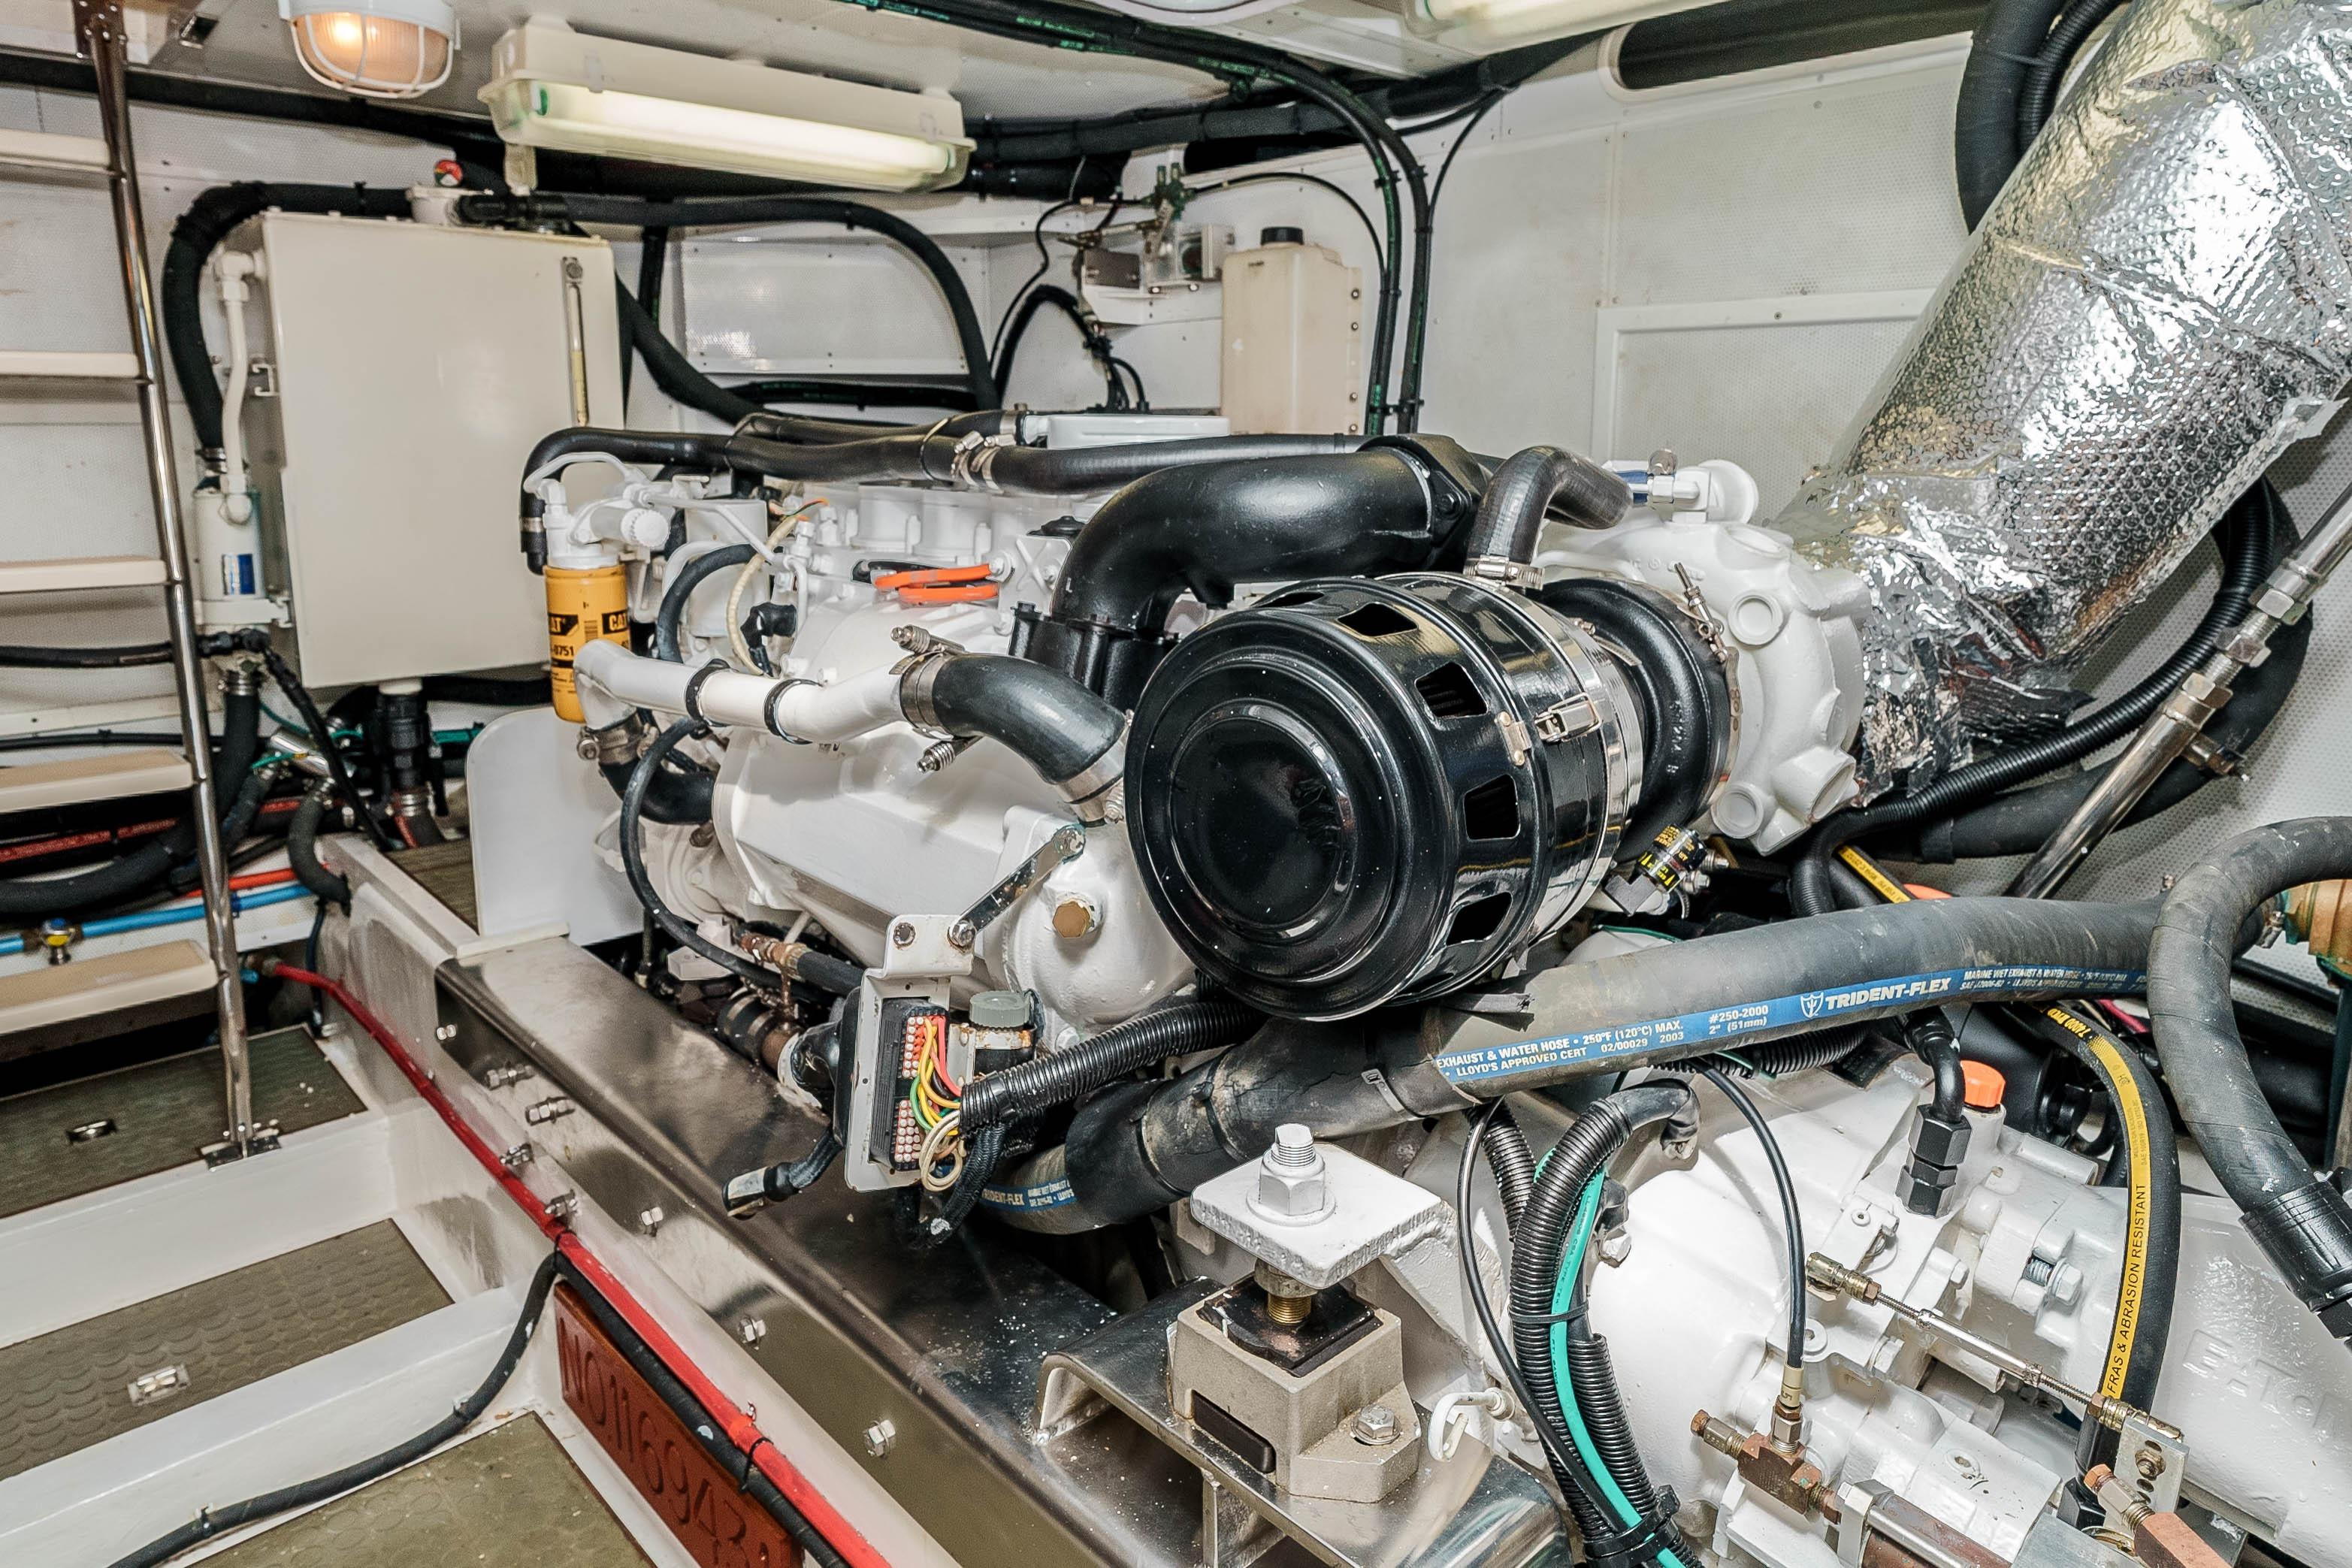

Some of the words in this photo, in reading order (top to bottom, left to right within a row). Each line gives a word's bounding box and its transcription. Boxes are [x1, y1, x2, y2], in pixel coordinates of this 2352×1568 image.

[609, 613, 627, 631] CAT
[551, 645, 574, 657] -0751
[1964, 969, 1993, 980] MARINE
[1993, 968, 2009, 978] WET
[1825, 977, 1951, 1010] TRIDENT-FLEX
[1436, 1052, 1485, 1068] EXHAUST
[1486, 1050, 1498, 1062] &
[1498, 1043, 1539, 1059] WATER
[1540, 1038, 1571, 1052] HOSE
[1655, 1020, 1684, 1033] MAX.
[1709, 1005, 1769, 1024] #250-2000
[1456, 1062, 1498, 1077] LLOYD'S
[1501, 1053, 1558, 1070] APPROVED
[1560, 1047, 1587, 1059] CERT
[1601, 1038, 1648, 1053] 02/00029
[1659, 1032, 1684, 1044] 2003
[1709, 1025, 1721, 1035] 2"
[1728, 1017, 1767, 1032] (51mm)
[2131, 1184, 2145, 1258] RESISTANT
[2119, 1262, 2141, 1340] ABRASION
[2116, 1343, 2126, 1352] &
[2107, 1355, 2124, 1394] FRAS
